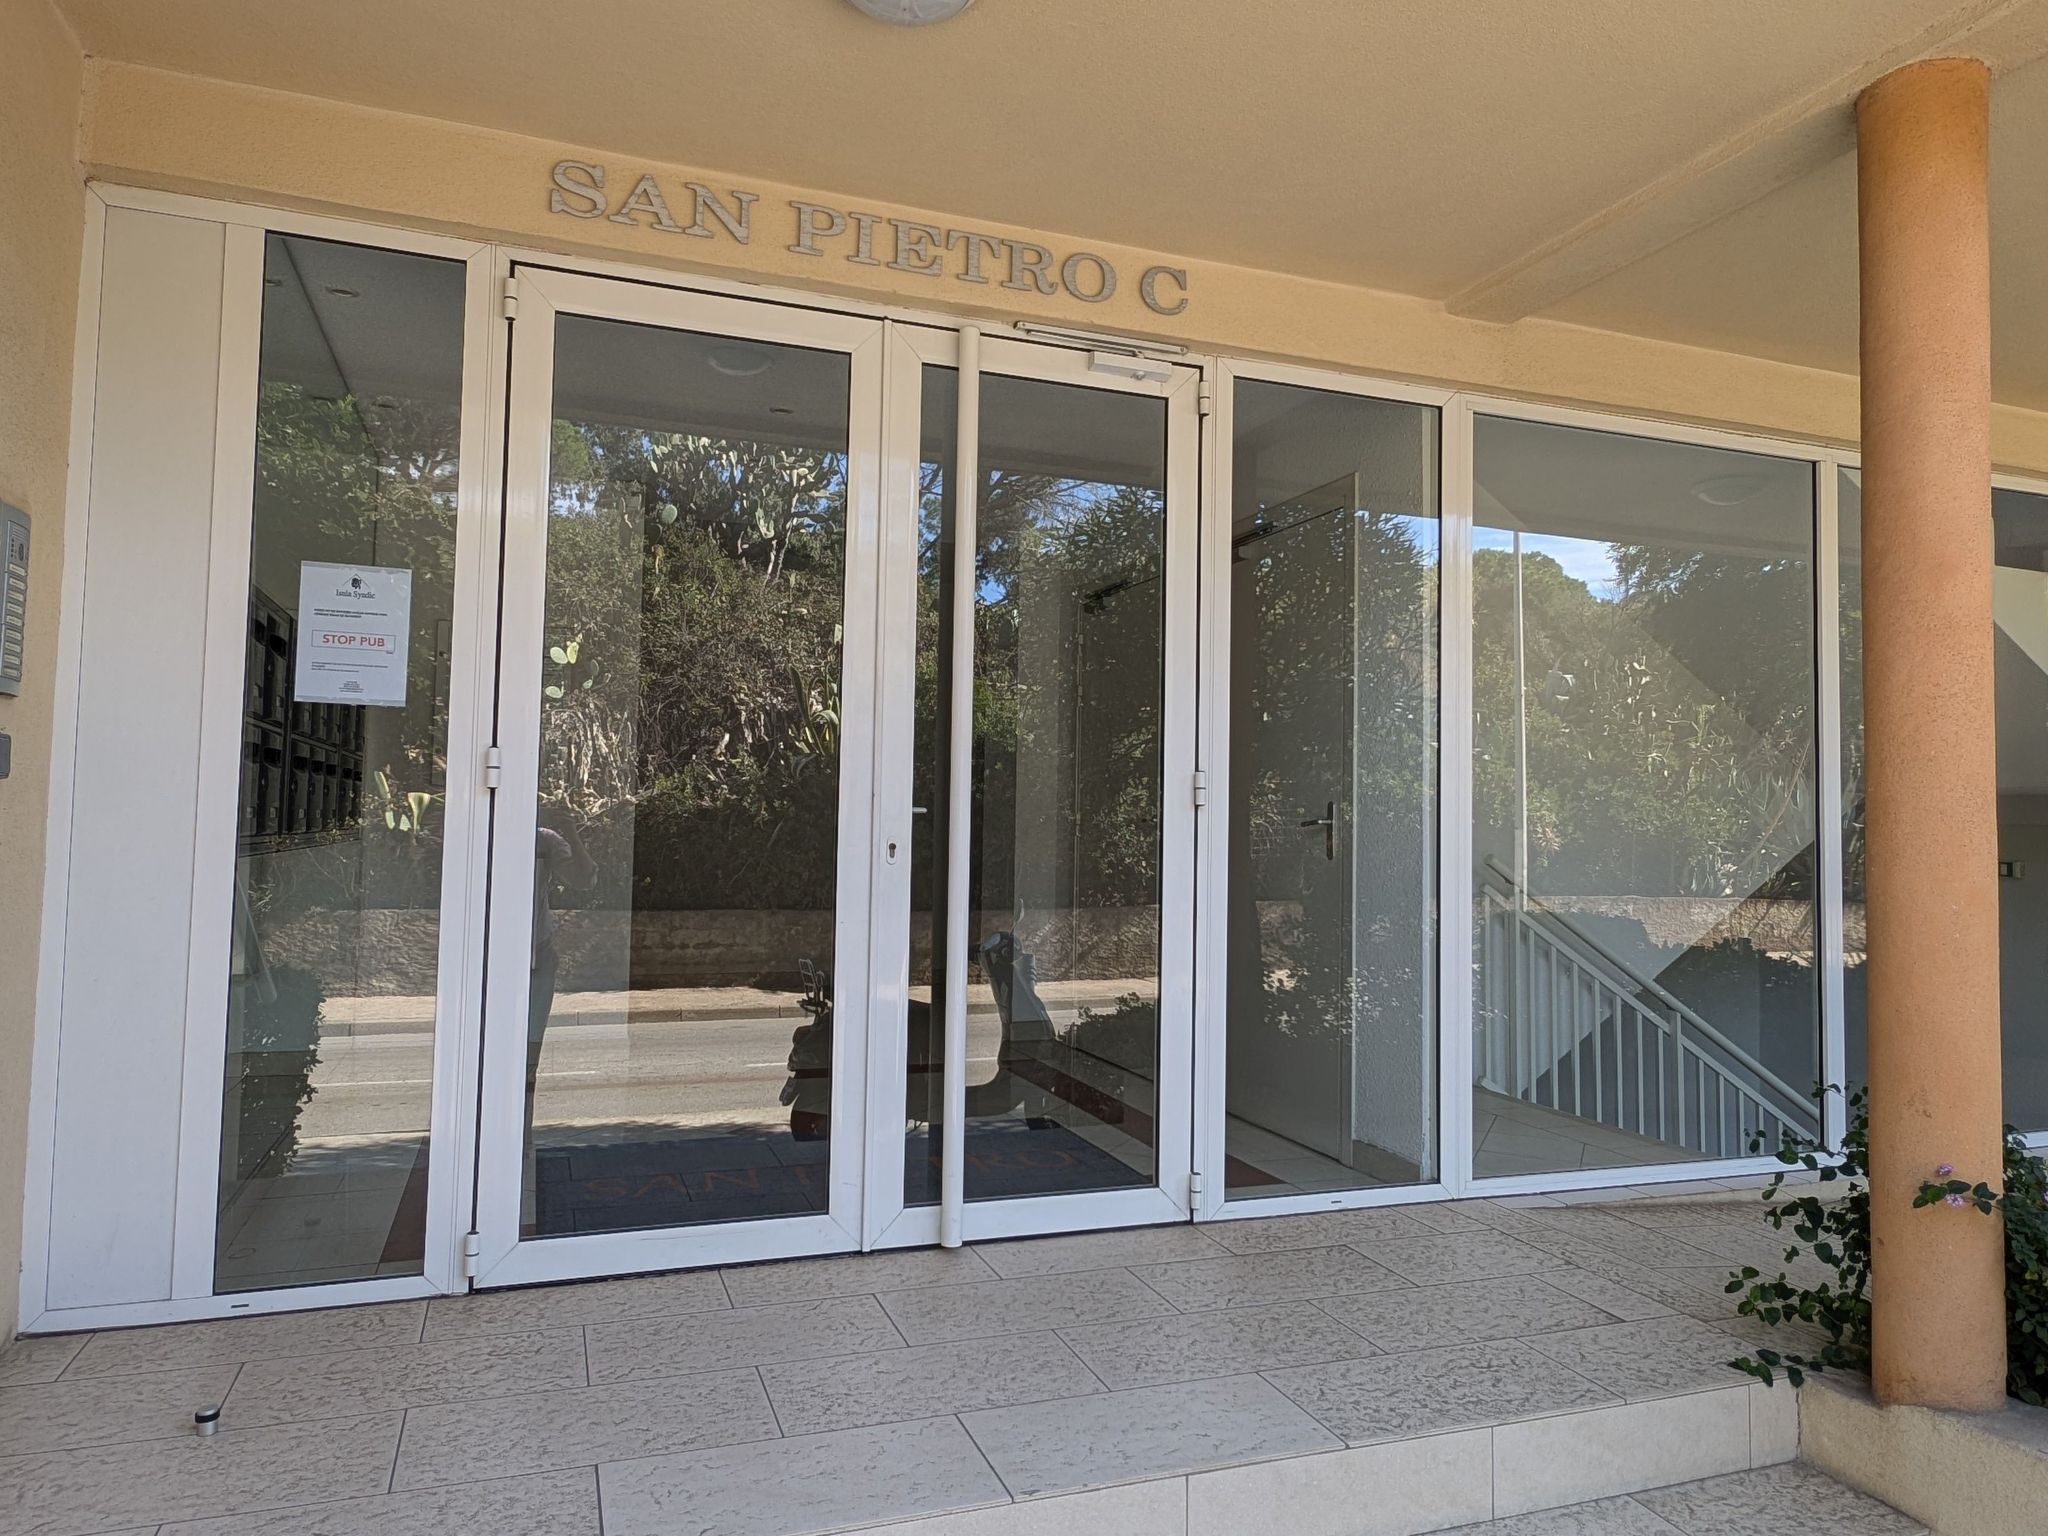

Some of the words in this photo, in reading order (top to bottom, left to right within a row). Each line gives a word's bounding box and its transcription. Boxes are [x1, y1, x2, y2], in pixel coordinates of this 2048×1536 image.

[549, 158, 760, 245] SAN
[787, 199, 1117, 304] PIETRO
[1139, 264, 1190, 317] C
[322, 634, 356, 645] STOP
[360, 637, 385, 647] PUB
